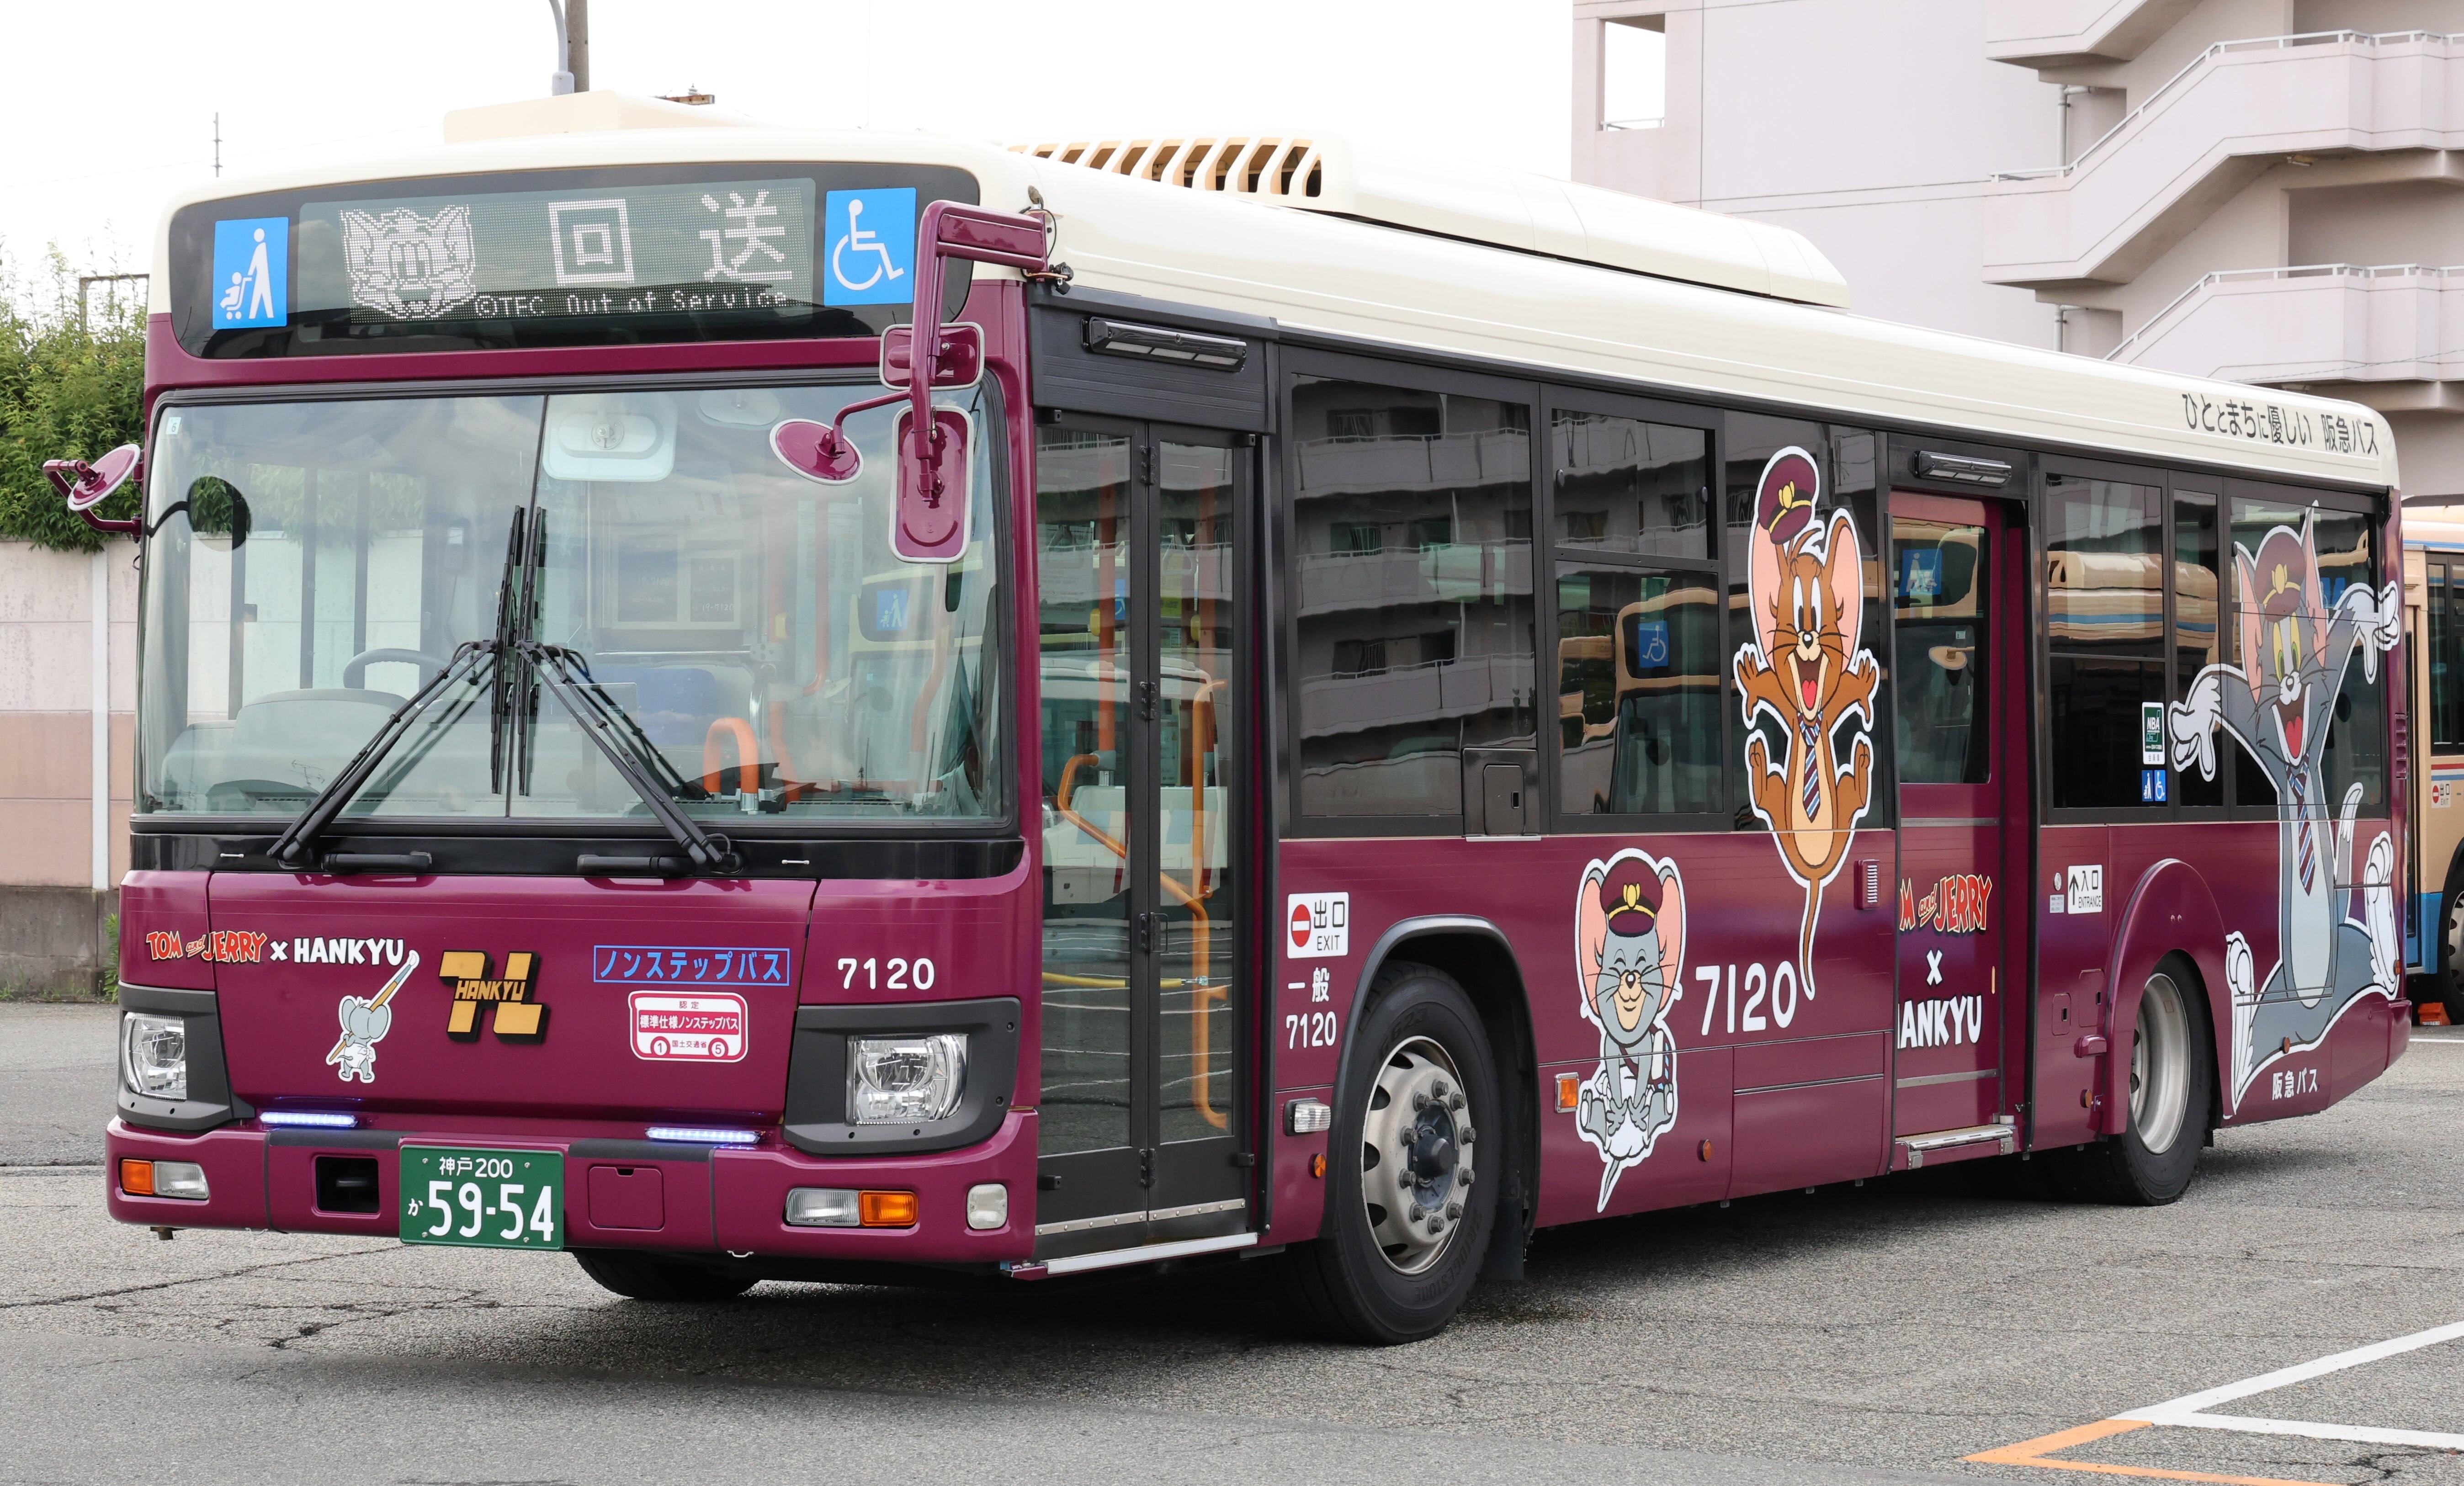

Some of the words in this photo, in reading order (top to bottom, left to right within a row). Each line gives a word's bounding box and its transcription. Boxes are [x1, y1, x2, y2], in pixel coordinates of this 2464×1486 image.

[548, 189, 793, 286] 回送
[2182, 393, 2312, 445] ひととまちに優しい
[2321, 414, 2379, 455] 阪急バス
[2147, 717, 2160, 730] NBA
[2440, 783, 2450, 796] 出口
[2082, 870, 2098, 892] 入口
[1314, 900, 1345, 929] 出口
[1918, 883, 1938, 927] and
[1933, 874, 1992, 933] JERRY
[2079, 896, 2101, 908] ENTRANCE
[146, 931, 183, 960] TOM
[186, 934, 205, 957] and
[202, 930, 268, 963] JERRY
[294, 937, 404, 966] HANKYU
[1317, 935, 1340, 951] EXIT
[600, 950, 781, 981] ノンステップバス
[838, 958, 935, 990] 7120
[454, 980, 526, 1001] HANKYU
[1288, 967, 1330, 1002] 一般
[1695, 961, 1797, 1036] 7120
[679, 1001, 699, 1009] 認定
[640, 1014, 738, 1030] 標準仕様ノンステップバス
[1286, 1011, 1336, 1050] 7120
[1897, 995, 1982, 1049] ANKYU
[657, 1043, 662, 1053] 1
[672, 1040, 707, 1048] 国土交通省
[715, 1044, 722, 1055] 5
[2272, 1067, 2318, 1100] 阪急バス
[408, 1198, 423, 1216] か
[429, 1181, 554, 1242] 59-54
